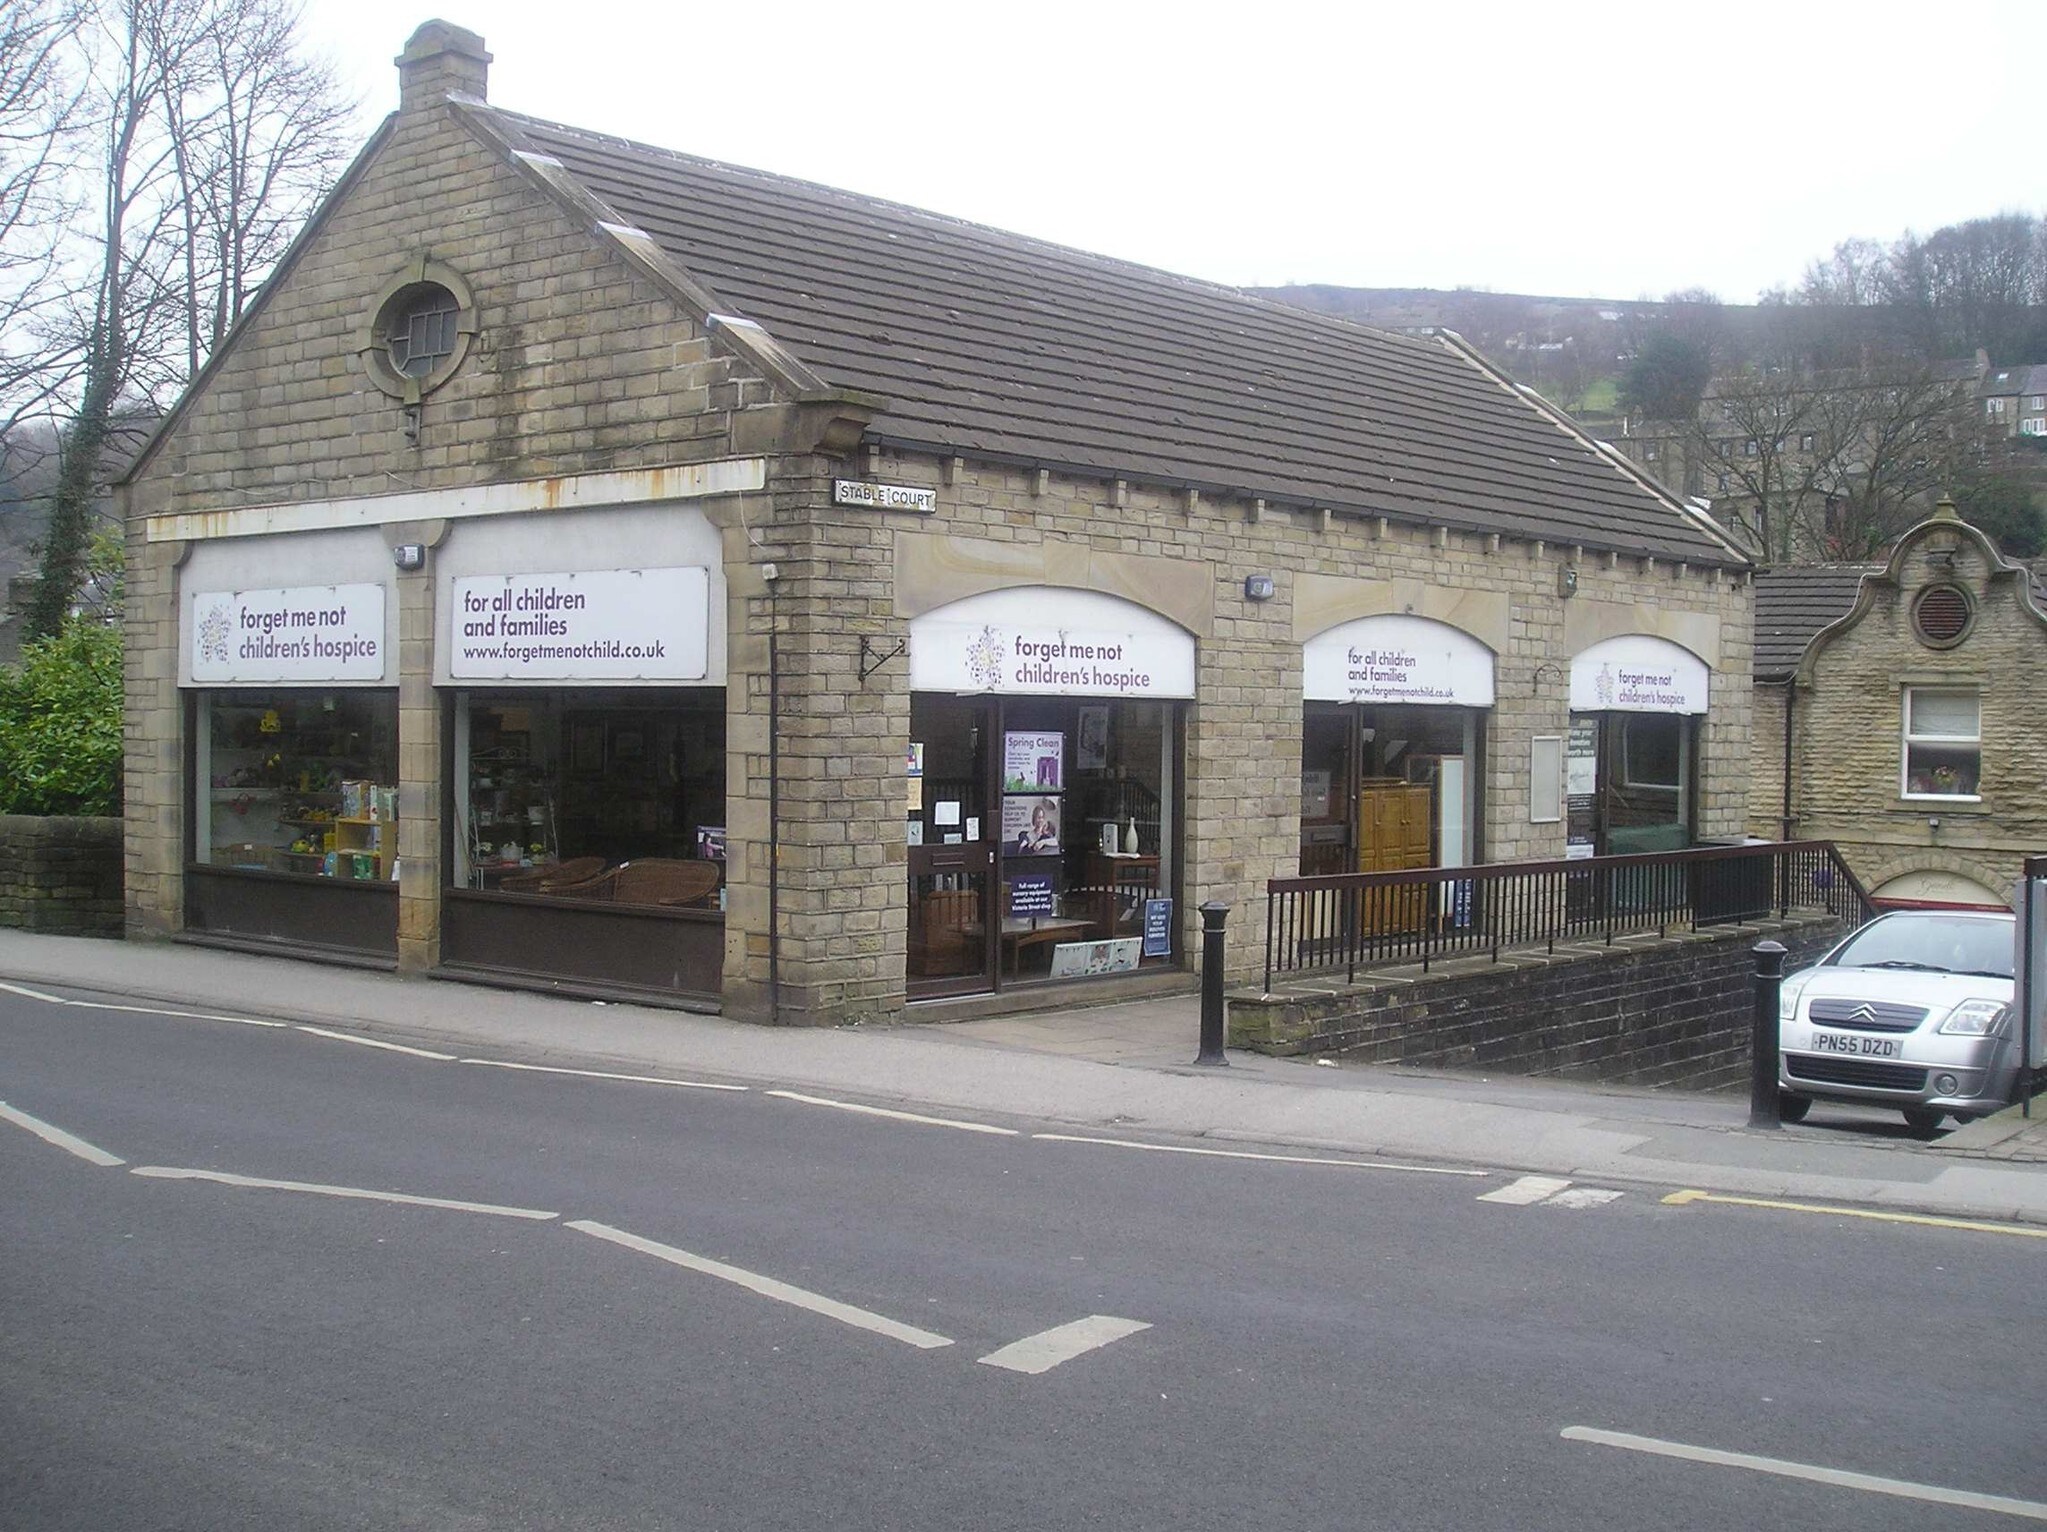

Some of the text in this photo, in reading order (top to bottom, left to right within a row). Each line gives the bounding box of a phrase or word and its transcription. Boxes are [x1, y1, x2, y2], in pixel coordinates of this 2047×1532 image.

[841, 485, 932, 506] STABLE COURT
[464, 587, 585, 612] for all children
[240, 606, 346, 634] forget me not
[464, 613, 567, 637] and families
[239, 633, 377, 663] children's hospice
[464, 640, 665, 662] www.forgetmenotchild.co.uk
[1015, 635, 1122, 662] forget me not
[1348, 650, 1416, 667] for all children
[1015, 662, 1150, 691] children's hospice
[1348, 667, 1407, 682] and families
[1619, 669, 1672, 687] forget me not
[1348, 685, 1455, 698] www.forgetmenotchild.co.uk
[1619, 688, 1685, 707] children's hospice
[1008, 736, 1060, 750] Spring Clean
[1818, 1034, 1894, 1056] PN55 DZD
